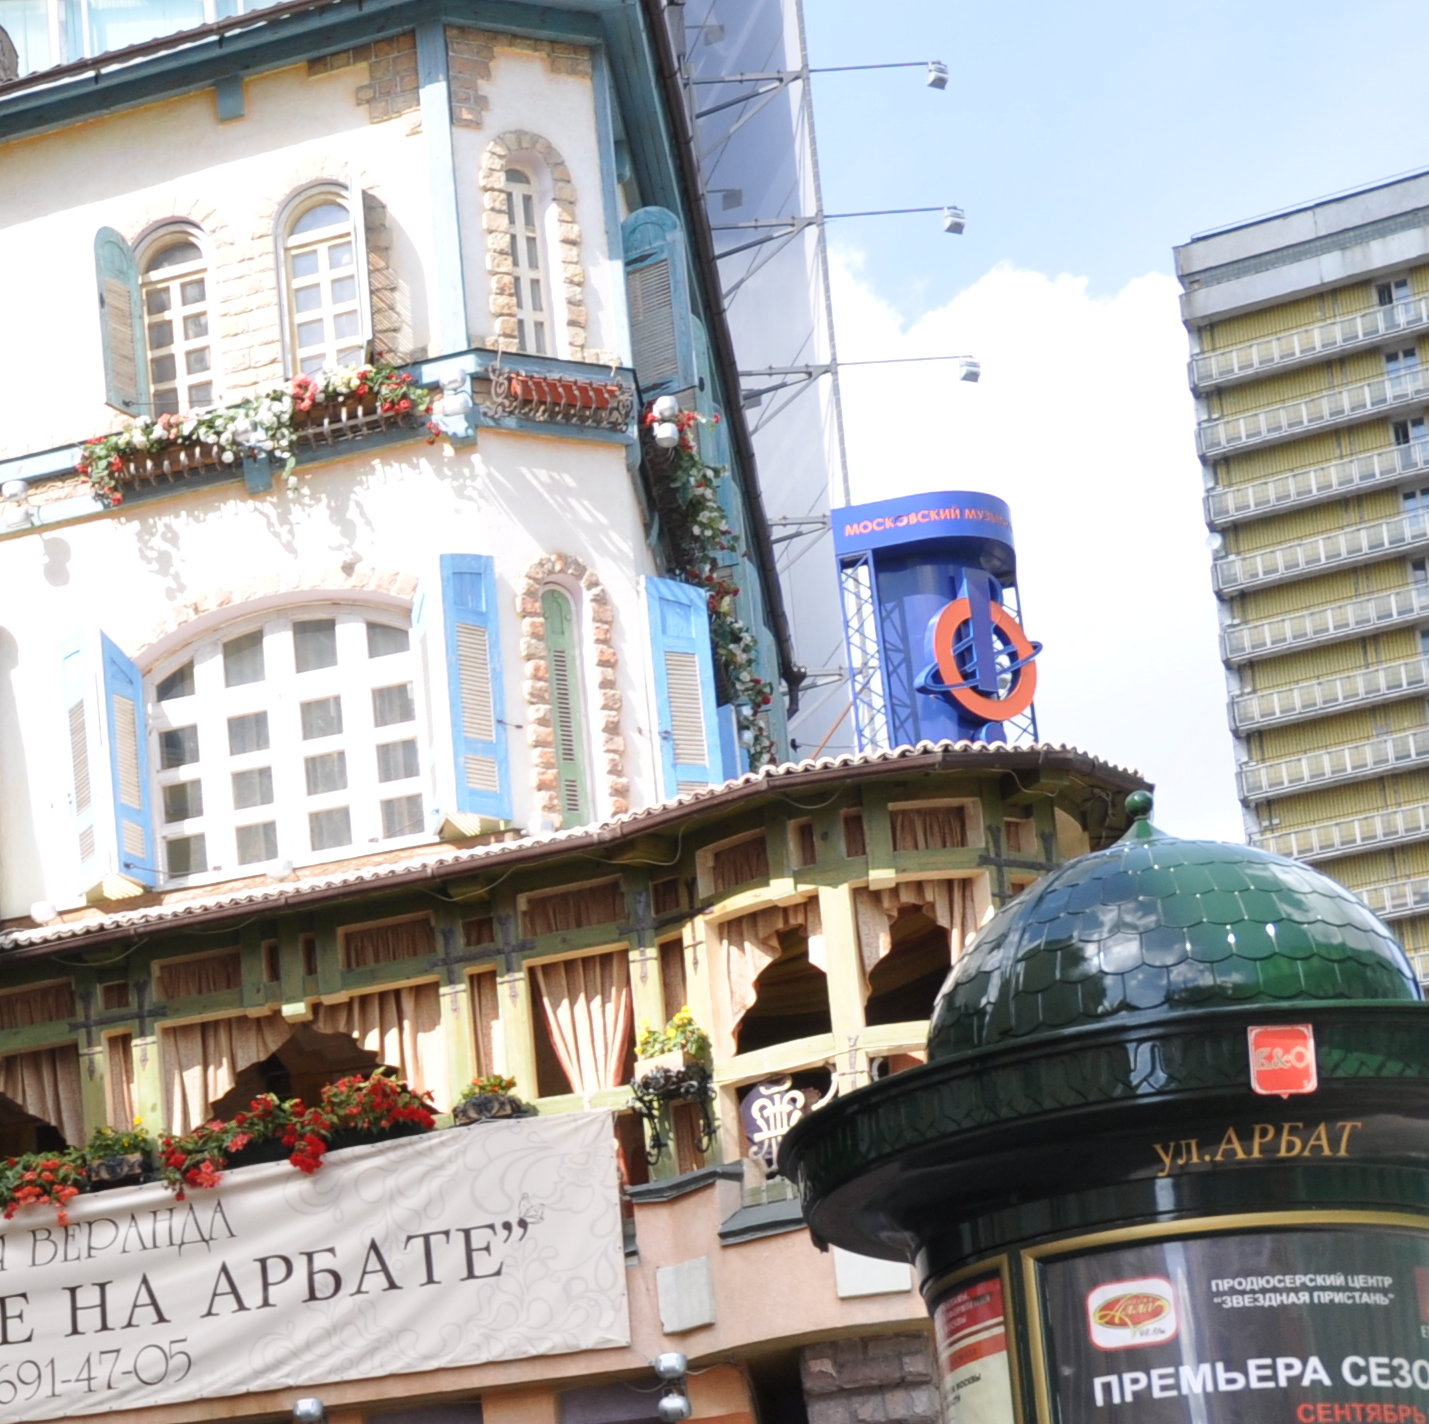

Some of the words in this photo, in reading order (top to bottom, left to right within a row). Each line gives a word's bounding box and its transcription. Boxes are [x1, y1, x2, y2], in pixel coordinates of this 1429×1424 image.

[844, 506, 960, 537] МОСКОВСКИЙ
[28, 1198, 237, 1268] ВЕРАНДА
[1210, 1273, 1345, 1293] ПРОДЮСЕРСКИЙ
[1347, 1274, 1393, 1289] ЦЕНТР
[62, 1272, 171, 1338] НА
[1093, 1355, 1332, 1407] ПРЕМЬЕРА
[1297, 1402, 1427, 1424] СЕНТЯБРЬ
